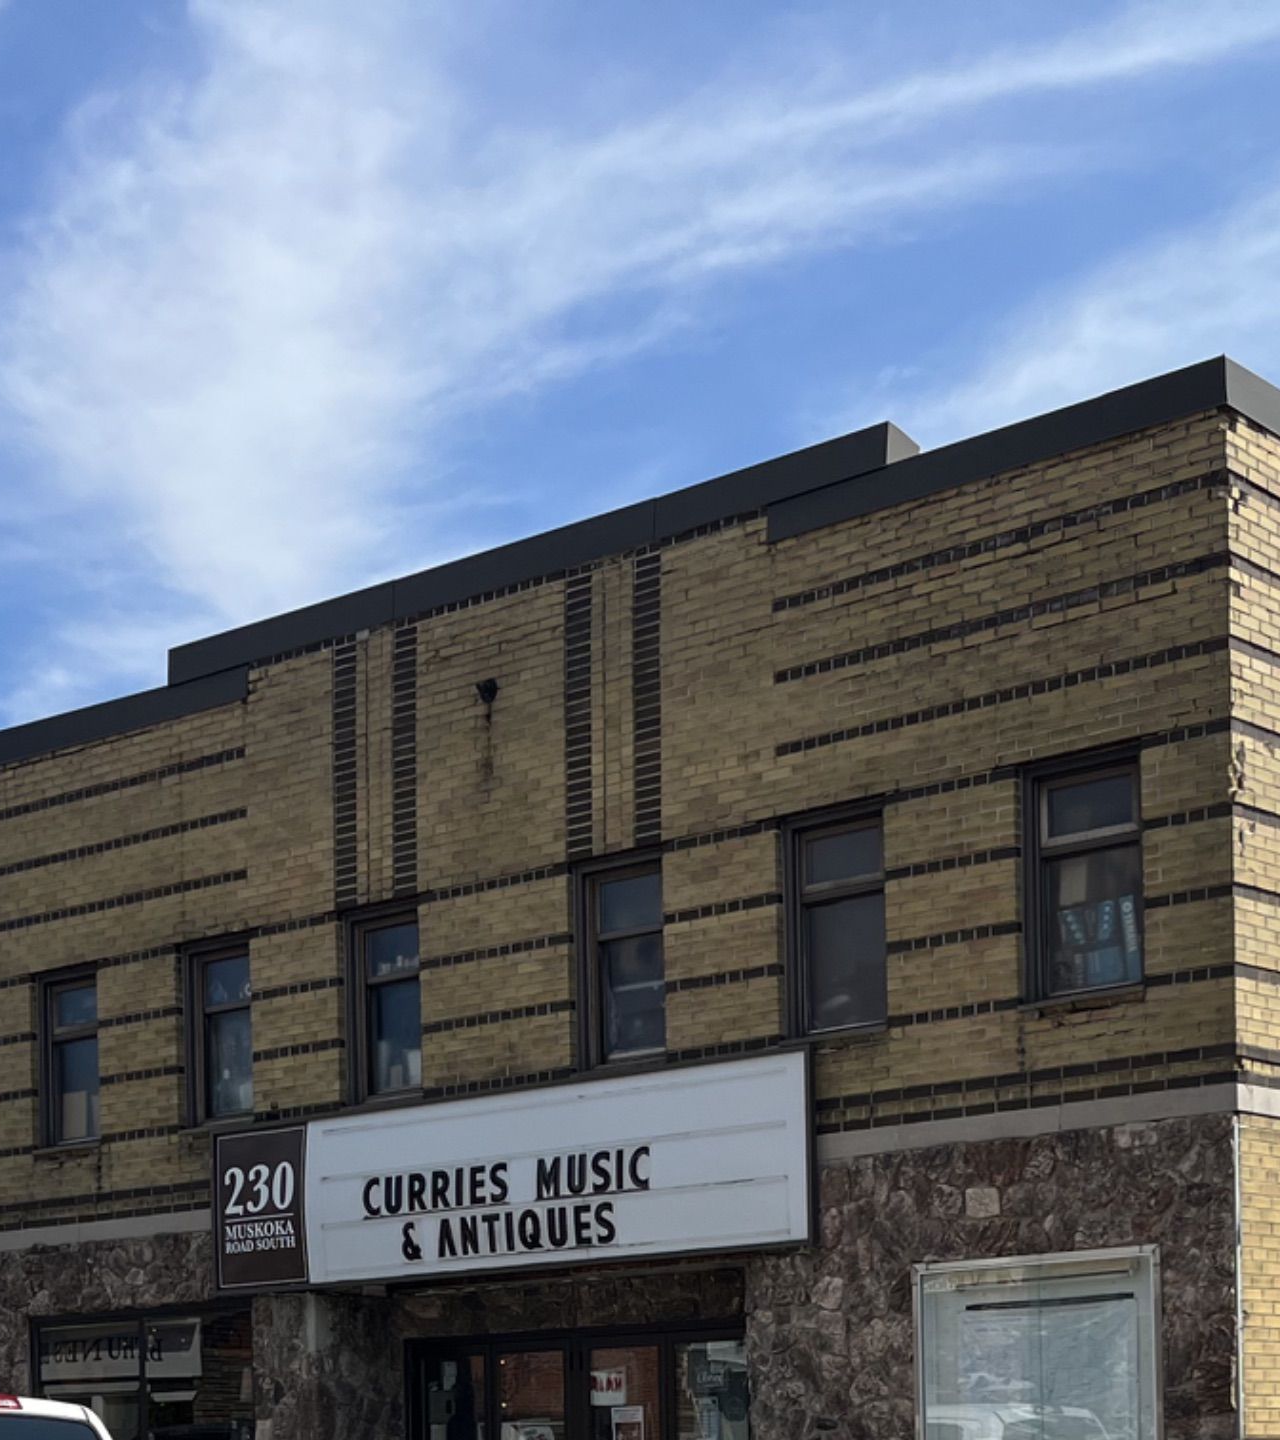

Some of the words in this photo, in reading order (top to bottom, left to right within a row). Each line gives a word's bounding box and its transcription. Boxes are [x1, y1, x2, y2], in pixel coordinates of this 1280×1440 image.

[224, 1161, 294, 1216] 230
[363, 1161, 509, 1217] CURRIES
[535, 1146, 651, 1199] MUSIC
[225, 1219, 294, 1240] MUSKOKA
[225, 1240, 254, 1254] ROAD
[256, 1236, 296, 1251] SOUTH
[402, 1221, 422, 1260] &
[438, 1201, 616, 1257] ANTIQUES
